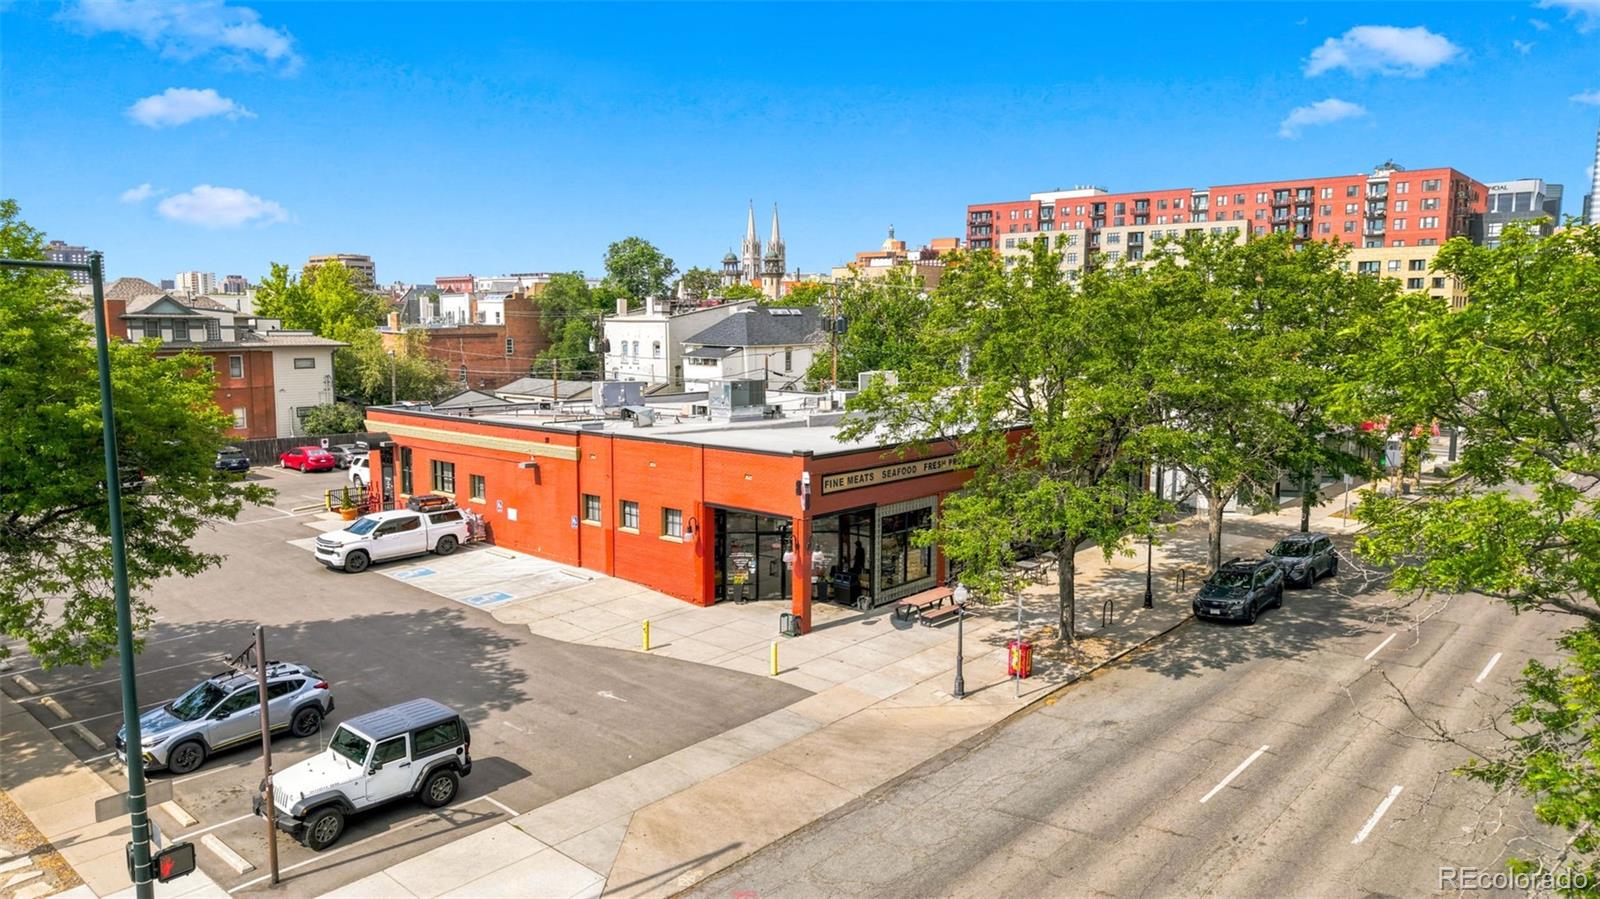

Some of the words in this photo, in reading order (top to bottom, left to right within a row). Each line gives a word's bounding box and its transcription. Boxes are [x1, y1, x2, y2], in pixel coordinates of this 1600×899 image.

[824, 477, 844, 489] FINE
[847, 472, 874, 484] MEATS
[882, 465, 917, 479] SEAFOOD
[923, 458, 947, 471] FRESH
